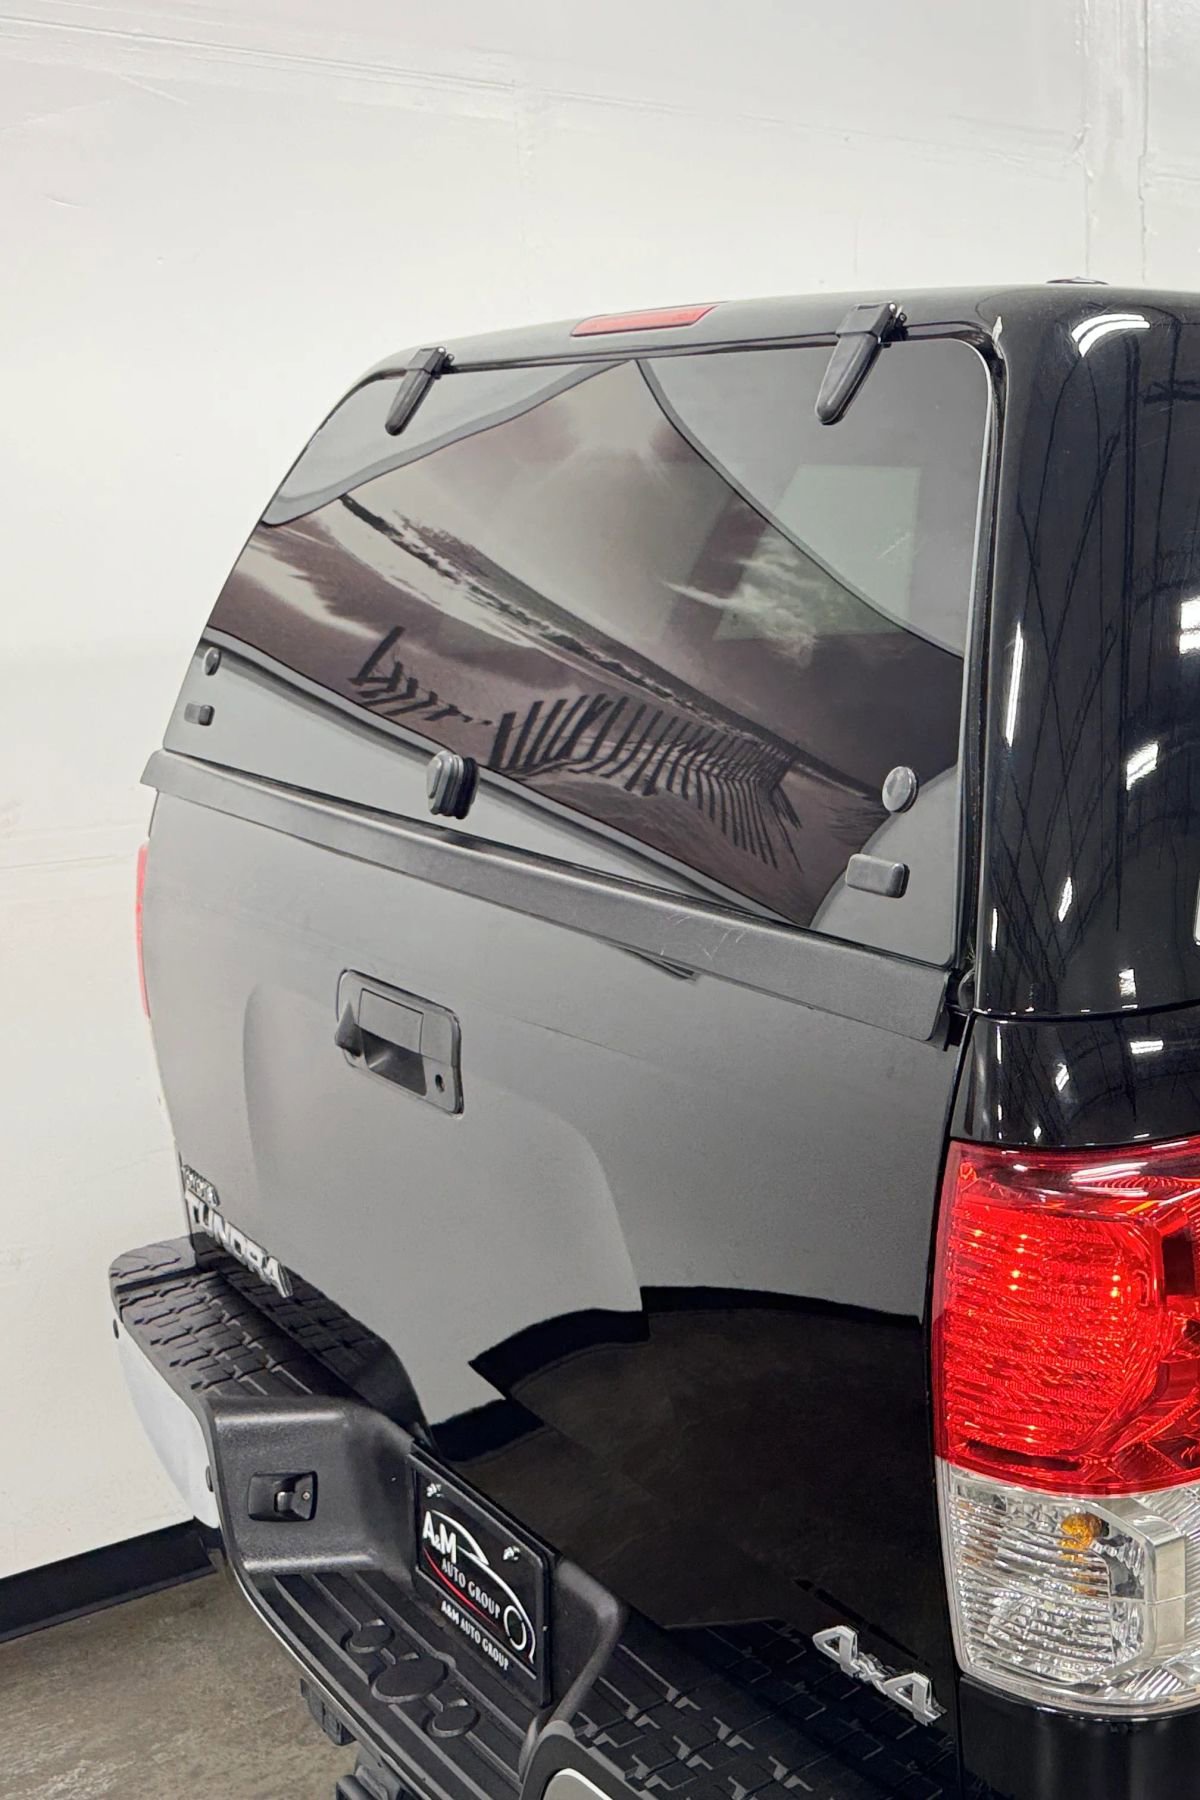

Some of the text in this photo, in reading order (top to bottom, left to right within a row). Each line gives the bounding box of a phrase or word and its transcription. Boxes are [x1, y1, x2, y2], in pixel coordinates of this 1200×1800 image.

[422, 1510, 457, 1565] A&M
[441, 1557, 501, 1619] AUTO GROUP
[440, 1599, 509, 1671] A&M AUTO GROUP
